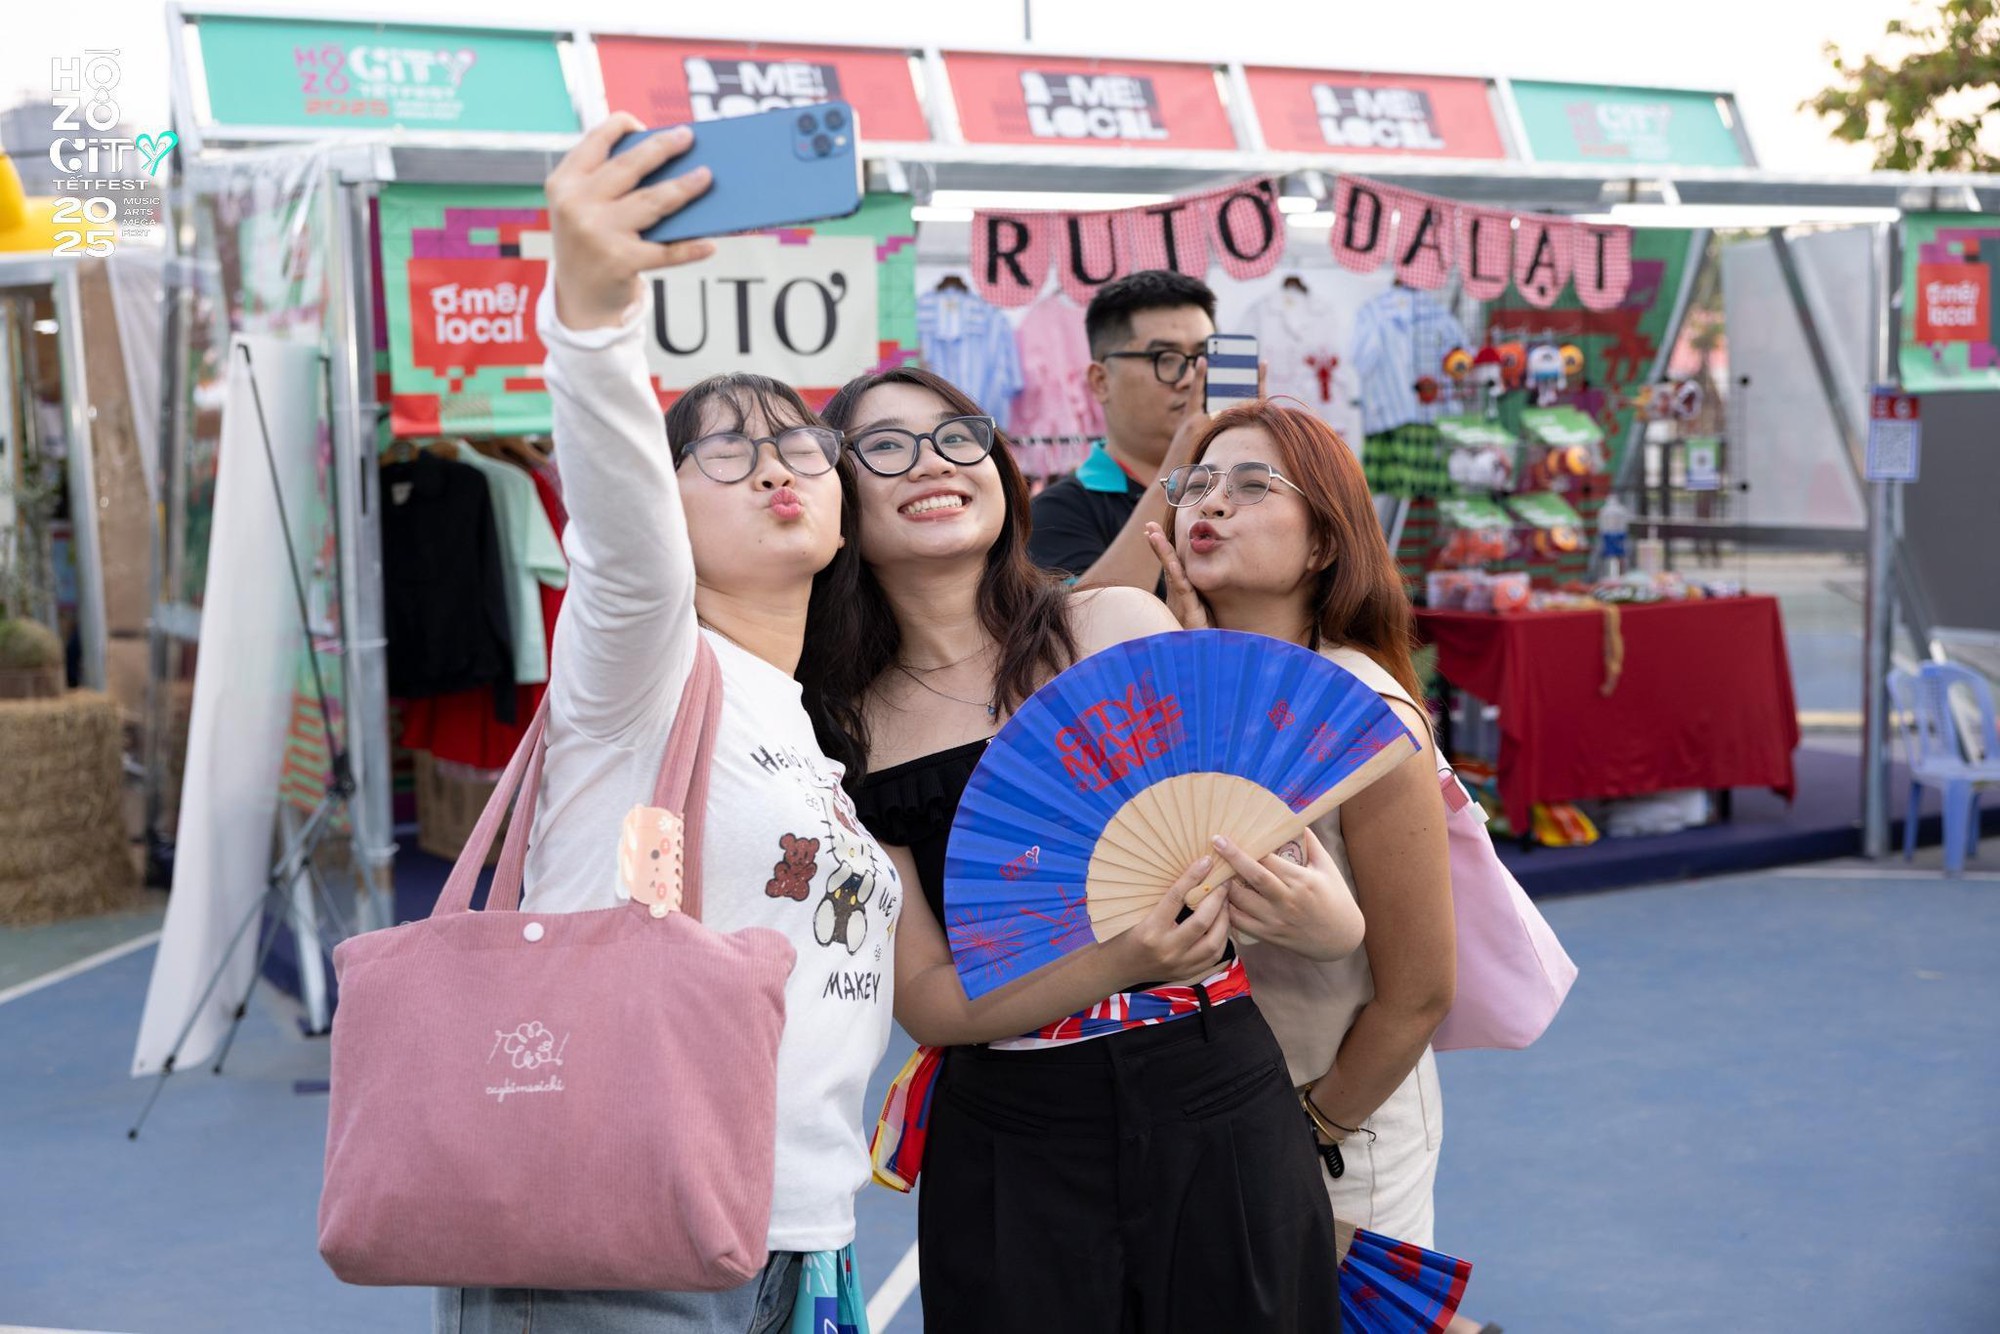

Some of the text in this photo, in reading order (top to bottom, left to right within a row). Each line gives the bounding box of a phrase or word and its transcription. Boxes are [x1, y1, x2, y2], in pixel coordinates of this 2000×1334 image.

[304, 99, 389, 117] 2025
[434, 312, 525, 345] local
[823, 971, 880, 1004] MAKEY
